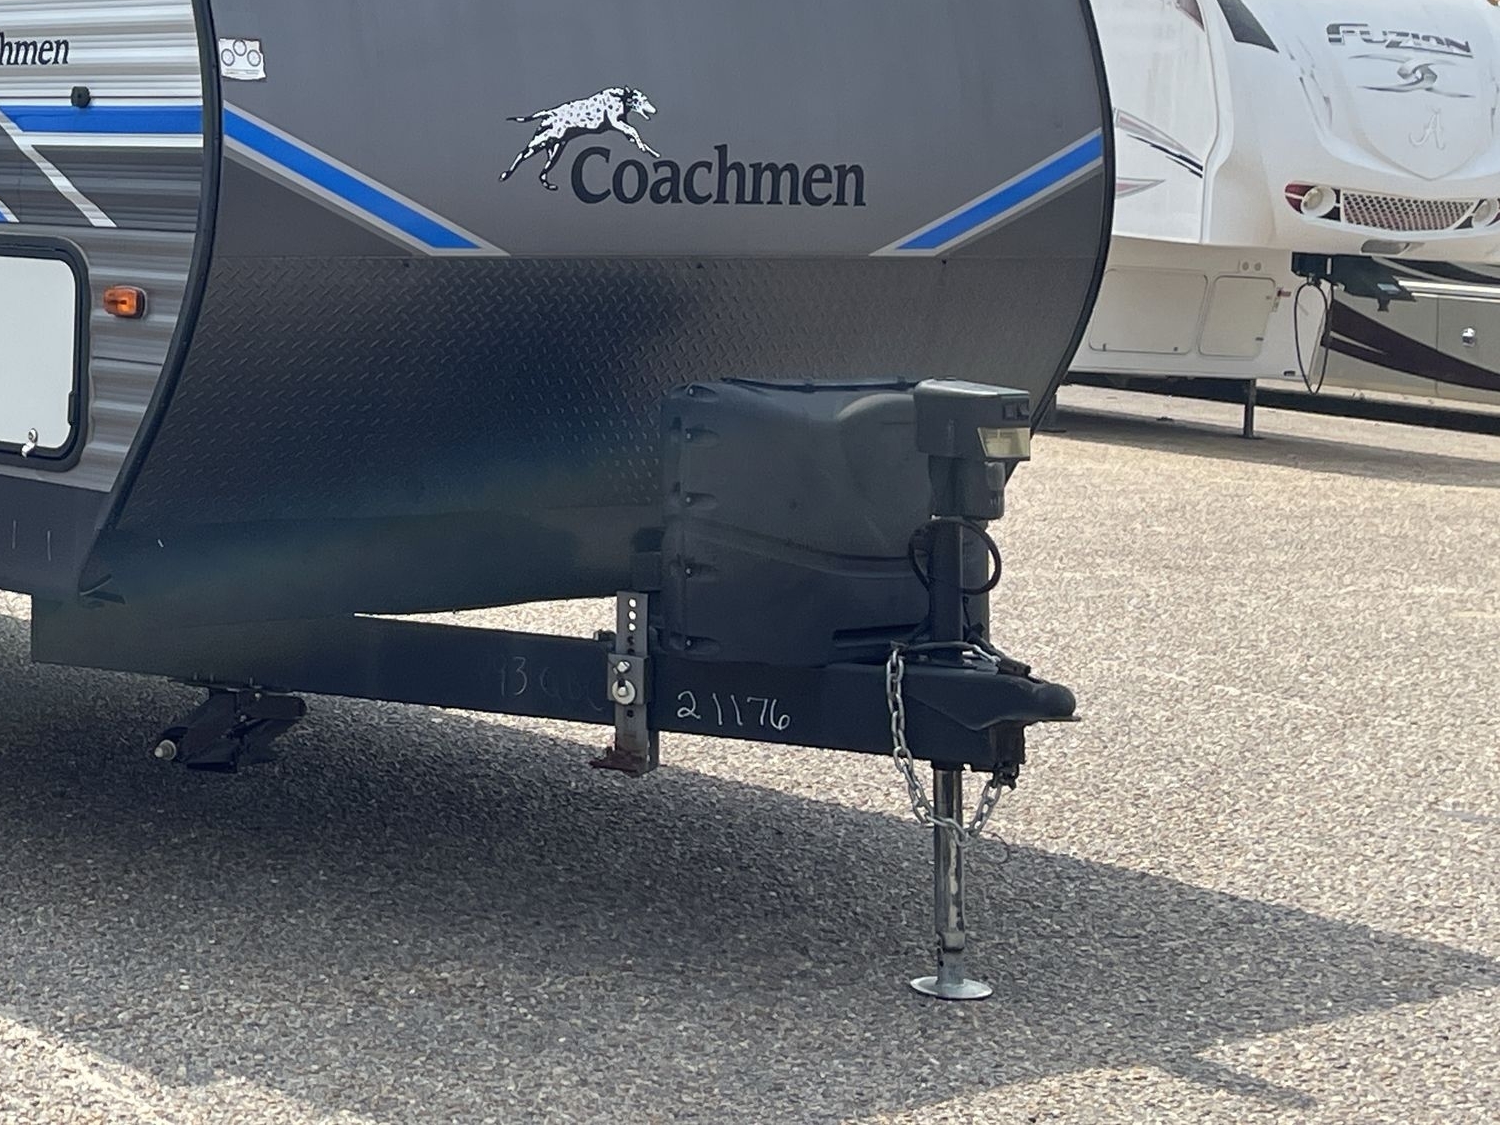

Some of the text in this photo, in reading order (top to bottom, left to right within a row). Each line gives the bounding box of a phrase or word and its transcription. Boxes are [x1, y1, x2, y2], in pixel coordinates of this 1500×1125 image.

[1326, 23, 1474, 59] FUZION
[570, 143, 867, 207] Coachmen
[677, 690, 791, 731] 21176
